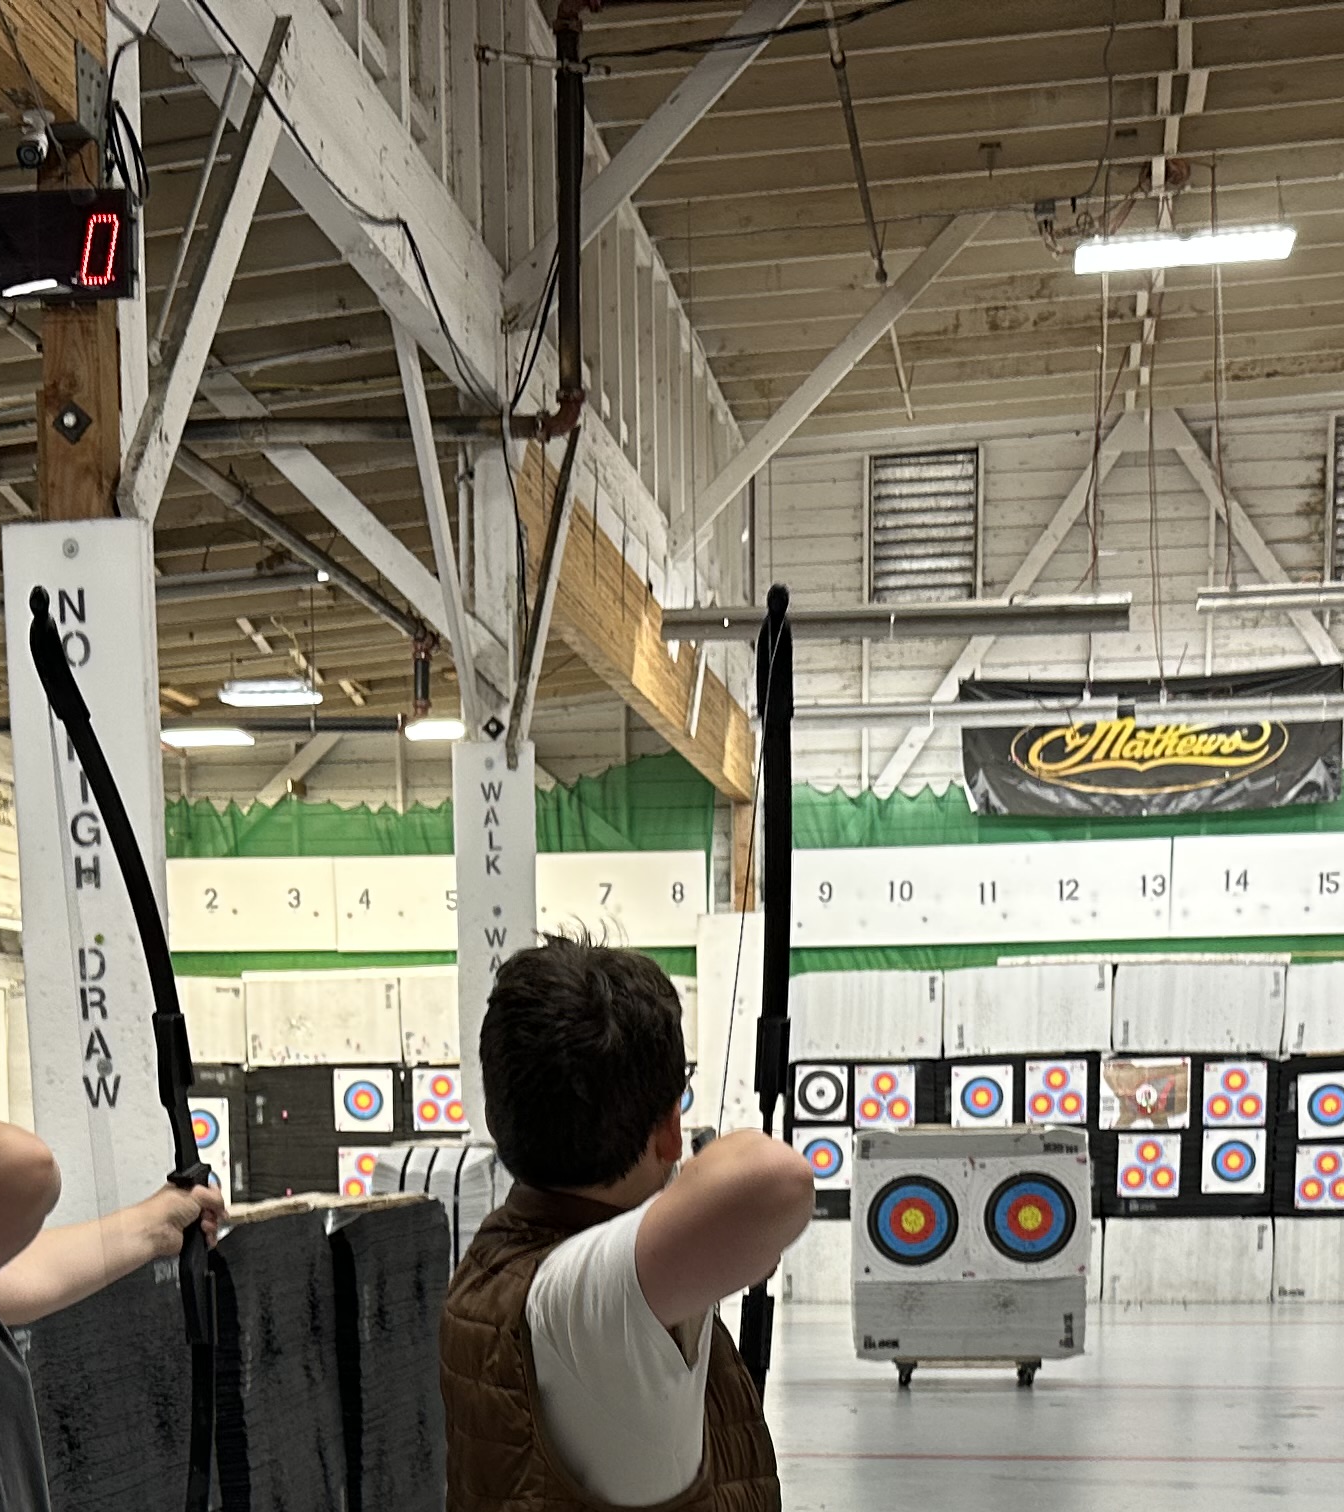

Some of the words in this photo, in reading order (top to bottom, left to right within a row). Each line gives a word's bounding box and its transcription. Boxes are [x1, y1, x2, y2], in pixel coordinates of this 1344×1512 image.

[81, 213, 118, 286] 0
[58, 586, 91, 670] NO
[1028, 716, 1272, 776] Mathews
[66, 722, 103, 890] IGH
[480, 780, 503, 876] WALK
[204, 887, 219, 912] 2
[287, 887, 302, 910] 3
[358, 888, 372, 910] 4
[445, 888, 458, 910] 5
[599, 882, 613, 906] 7
[671, 881, 685, 904] 8
[818, 881, 833, 903] 9
[889, 880, 914, 904] 10
[979, 880, 997, 906] 11
[1058, 878, 1080, 902] 12
[1141, 874, 1166, 898] 13
[1224, 869, 1249, 893] 14
[1318, 871, 1341, 895] 15
[484, 927, 507, 973] WA
[78, 946, 121, 1111] DRAW
